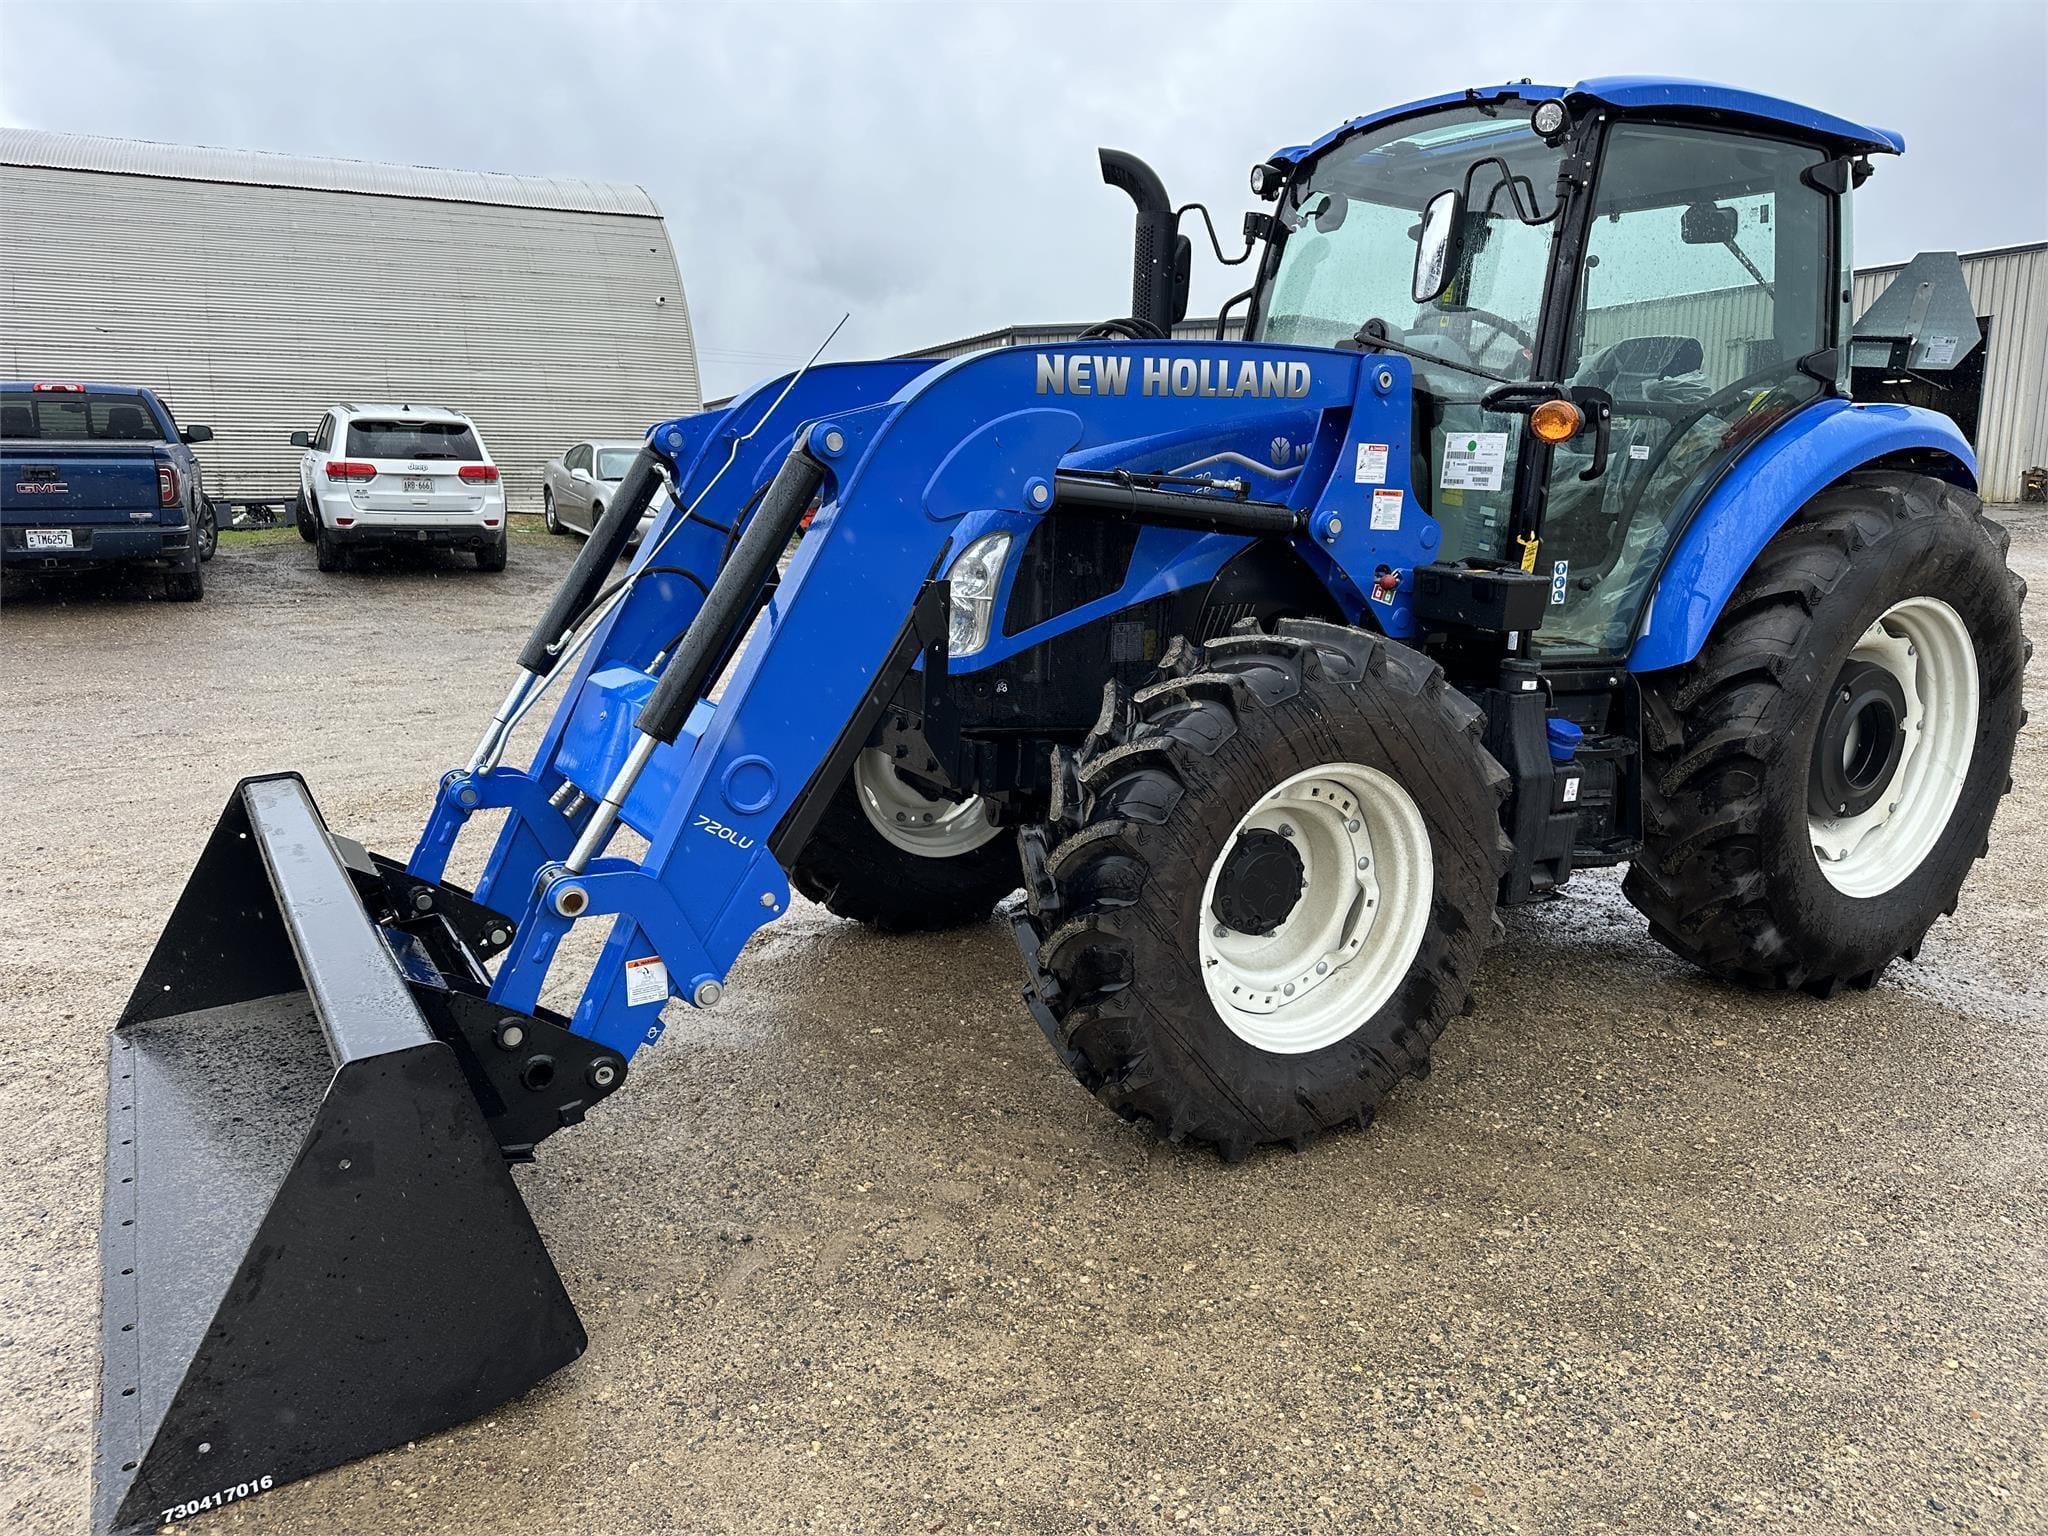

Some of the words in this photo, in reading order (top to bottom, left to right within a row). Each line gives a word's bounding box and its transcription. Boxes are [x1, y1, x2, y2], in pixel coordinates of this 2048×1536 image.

[1036, 354, 1131, 395] NEW
[1143, 357, 1311, 397] HOLLAND
[16, 482, 69, 493] GMC
[693, 814, 754, 849] 720LU
[161, 1475, 273, 1523] 730417016
